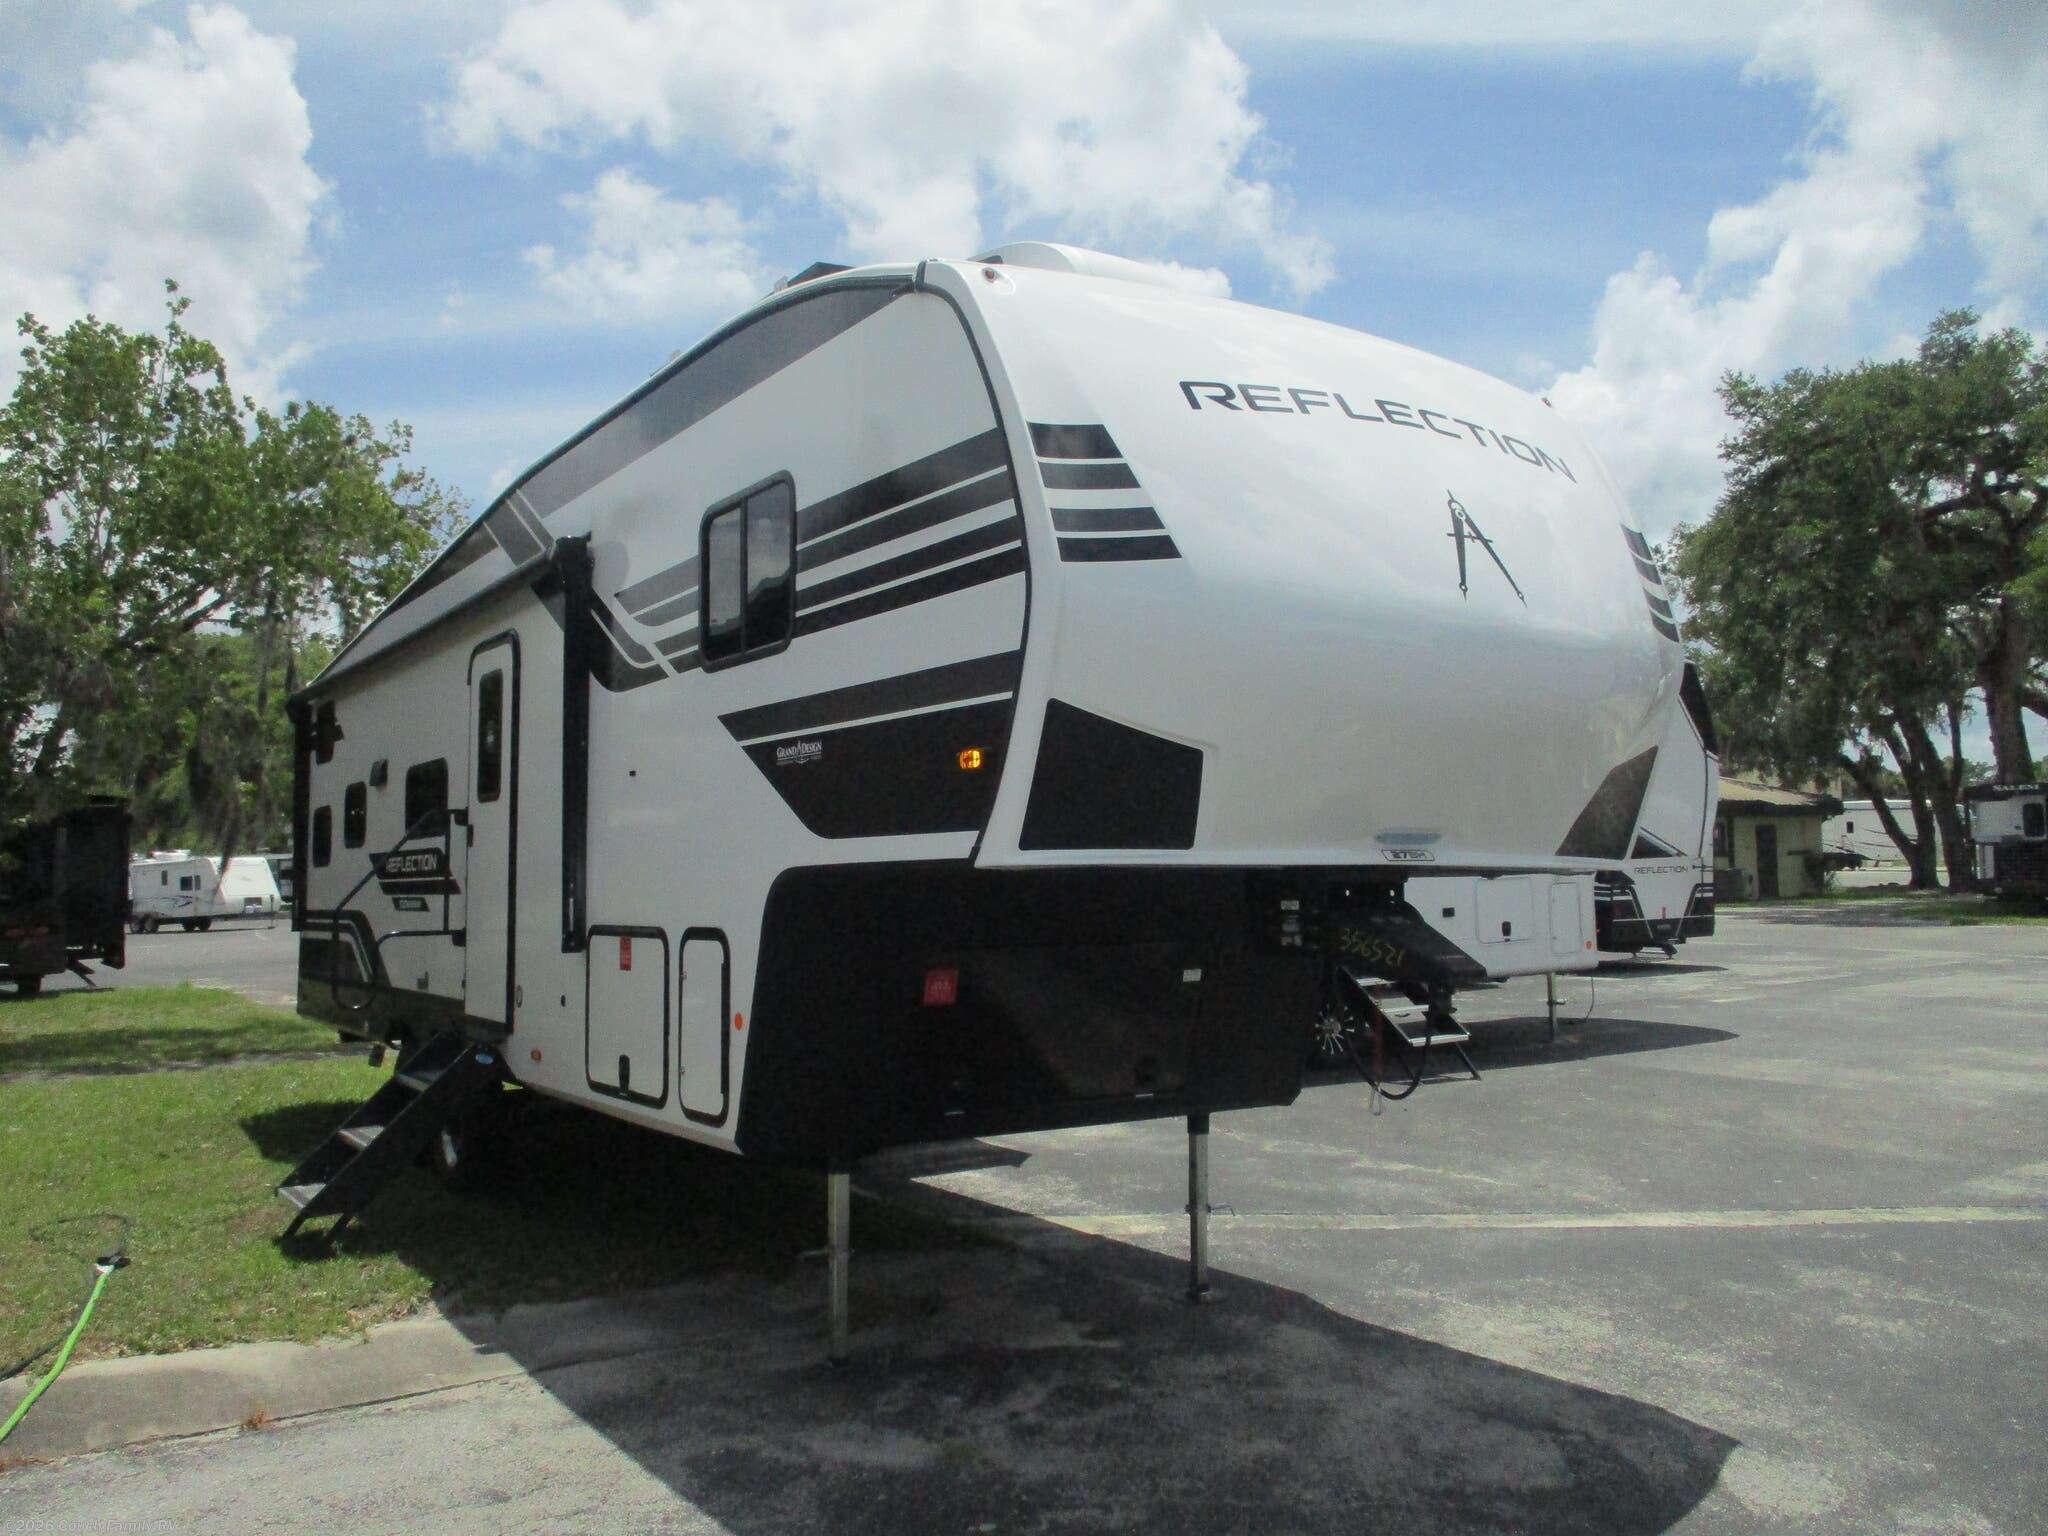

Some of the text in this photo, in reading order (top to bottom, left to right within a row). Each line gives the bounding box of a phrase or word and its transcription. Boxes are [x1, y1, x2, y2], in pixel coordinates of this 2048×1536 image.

[1179, 380, 1578, 483] REFLECTION
[776, 746, 797, 758] GRAND
[801, 741, 822, 753] DESIGN
[386, 853, 437, 873] REFLECTION
[1632, 865, 1689, 874] REFLECTION
